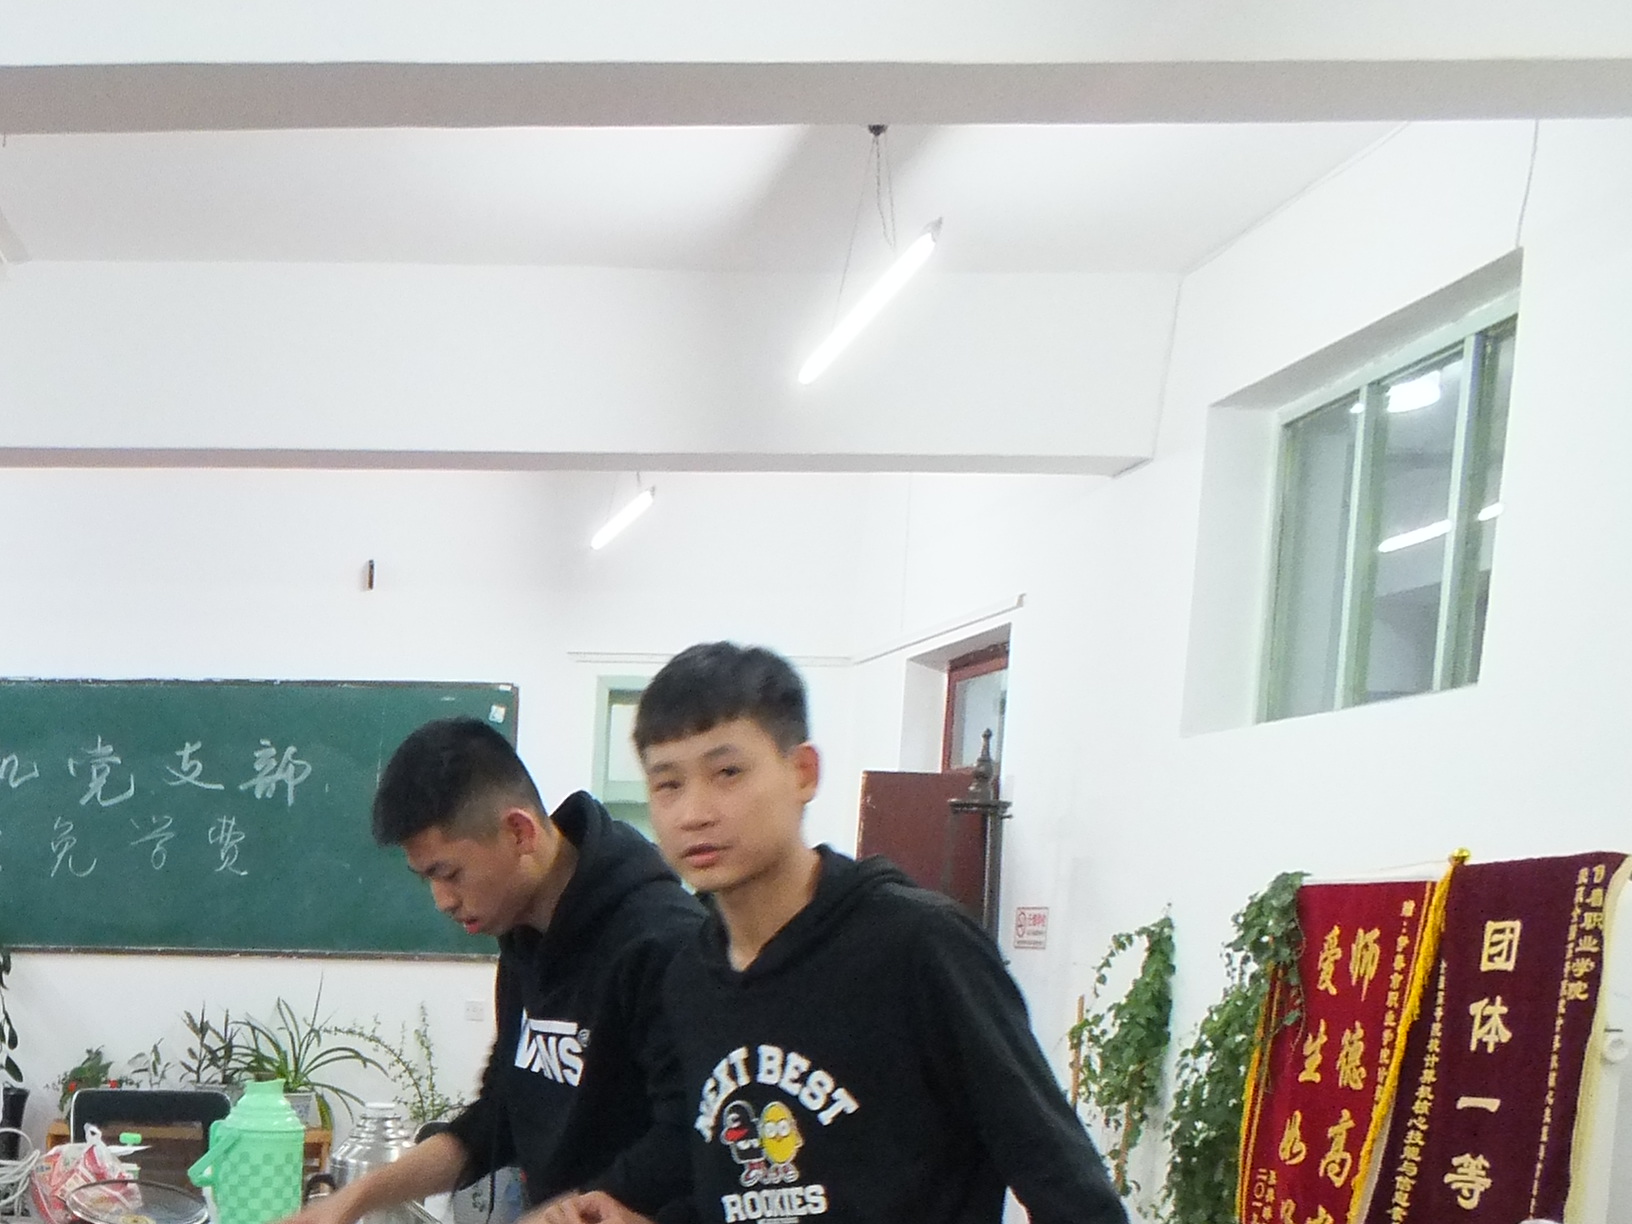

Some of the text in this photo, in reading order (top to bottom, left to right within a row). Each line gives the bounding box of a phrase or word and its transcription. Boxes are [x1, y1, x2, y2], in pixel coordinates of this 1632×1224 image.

[514, 1006, 586, 1087] VANS
[756, 1044, 860, 1127] BEST
[721, 1184, 829, 1224] ROOKIES
